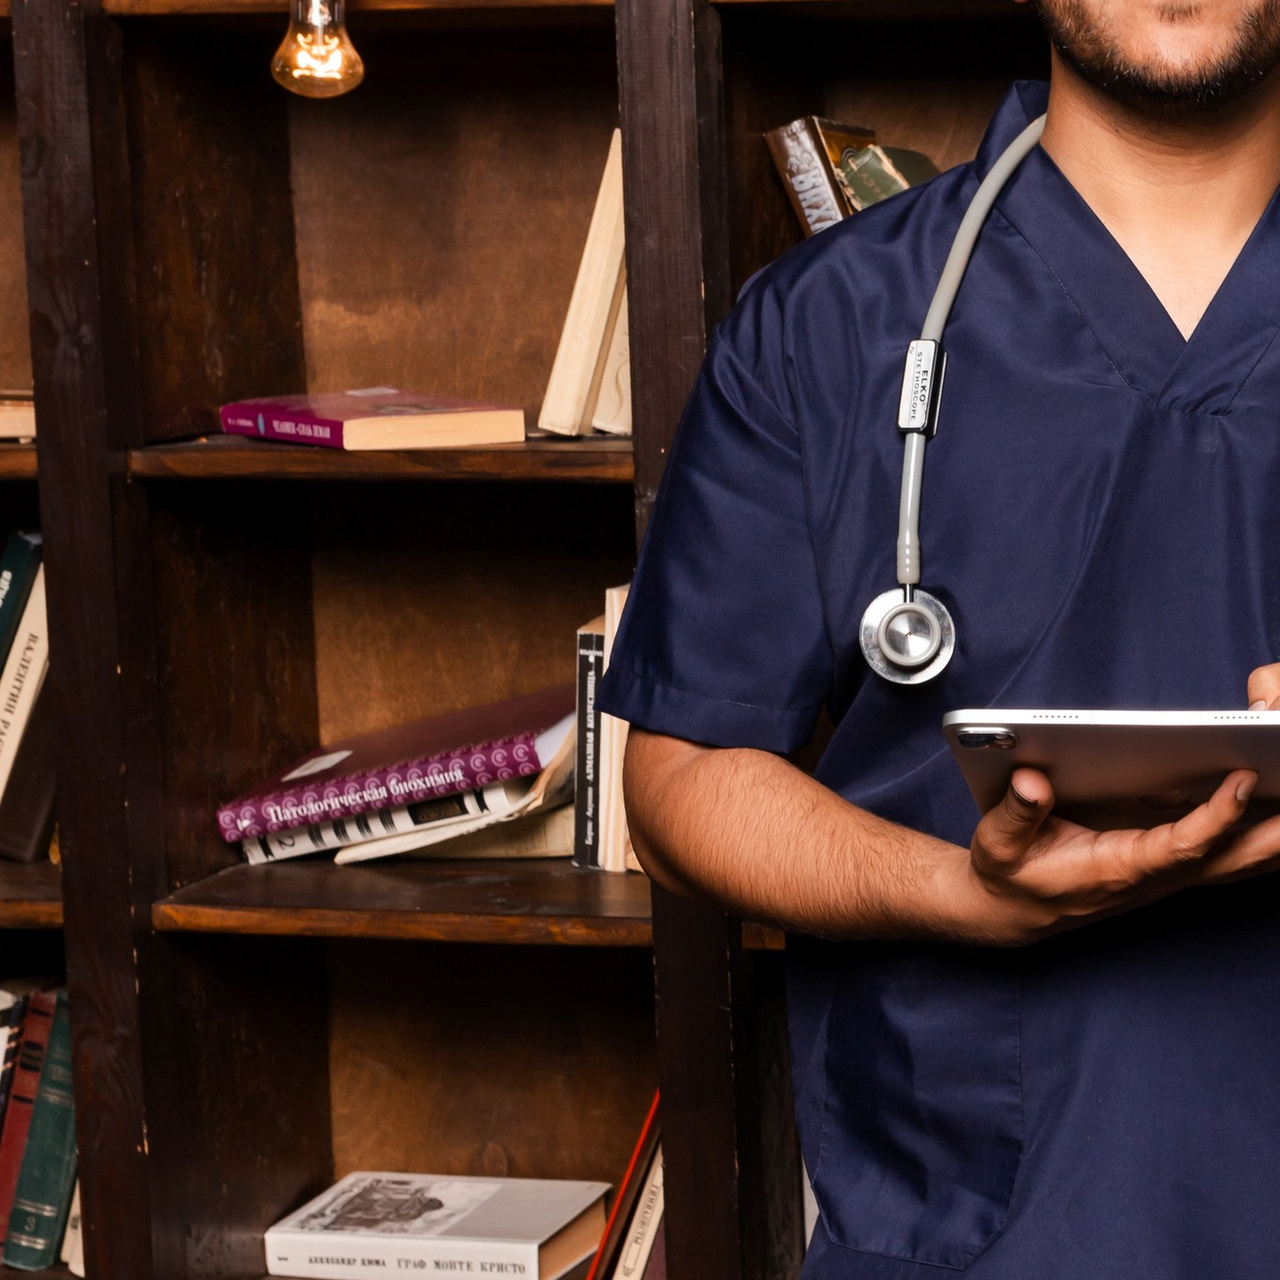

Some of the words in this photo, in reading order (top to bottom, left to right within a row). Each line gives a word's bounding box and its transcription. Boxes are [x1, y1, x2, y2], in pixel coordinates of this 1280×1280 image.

[911, 352, 922, 420] STETHOSCOPE
[918, 370, 928, 402] ELKO
[4, 632, 39, 716] ВАЛЕНТИН
[268, 784, 388, 824] Патологическая
[389, 768, 464, 800] биохимия
[277, 834, 296, 852] 2
[396, 1257, 428, 1271] ГРАФ
